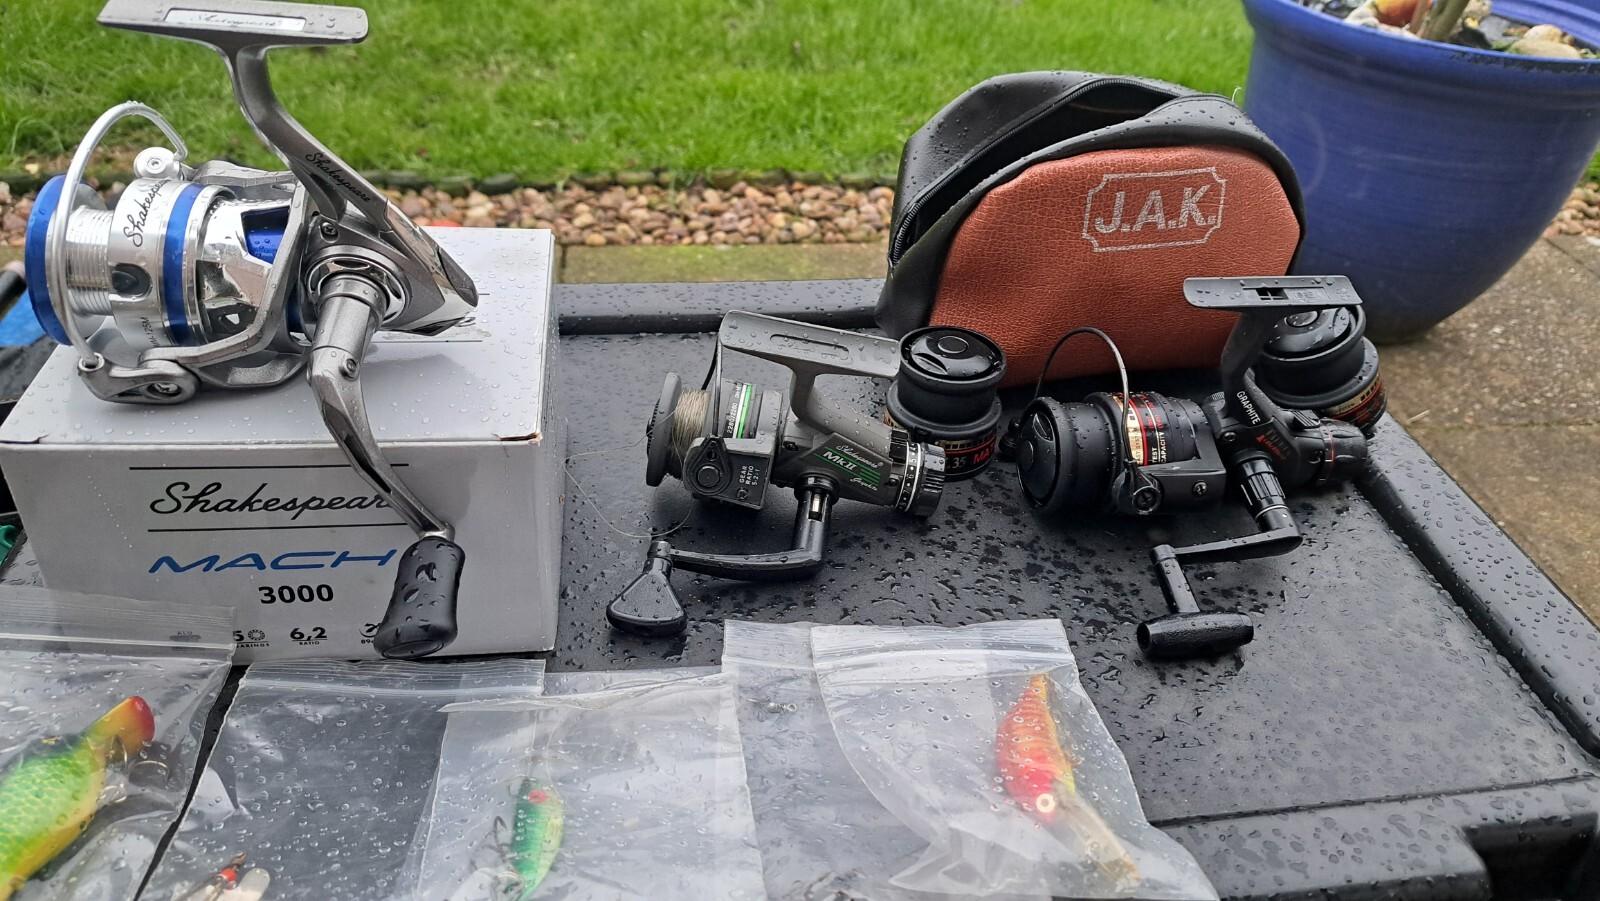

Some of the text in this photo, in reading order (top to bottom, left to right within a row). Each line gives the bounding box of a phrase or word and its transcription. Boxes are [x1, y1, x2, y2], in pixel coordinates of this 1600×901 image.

[305, 152, 371, 202] Shakespeare
[1094, 184, 1217, 234] J.A.K.
[1236, 390, 1261, 425] GRAPHITE
[739, 465, 748, 484] GEAR
[745, 465, 754, 485] RATIO
[148, 549, 397, 574] MACH
[258, 584, 334, 604] 3000
[290, 627, 327, 641] 6,2
